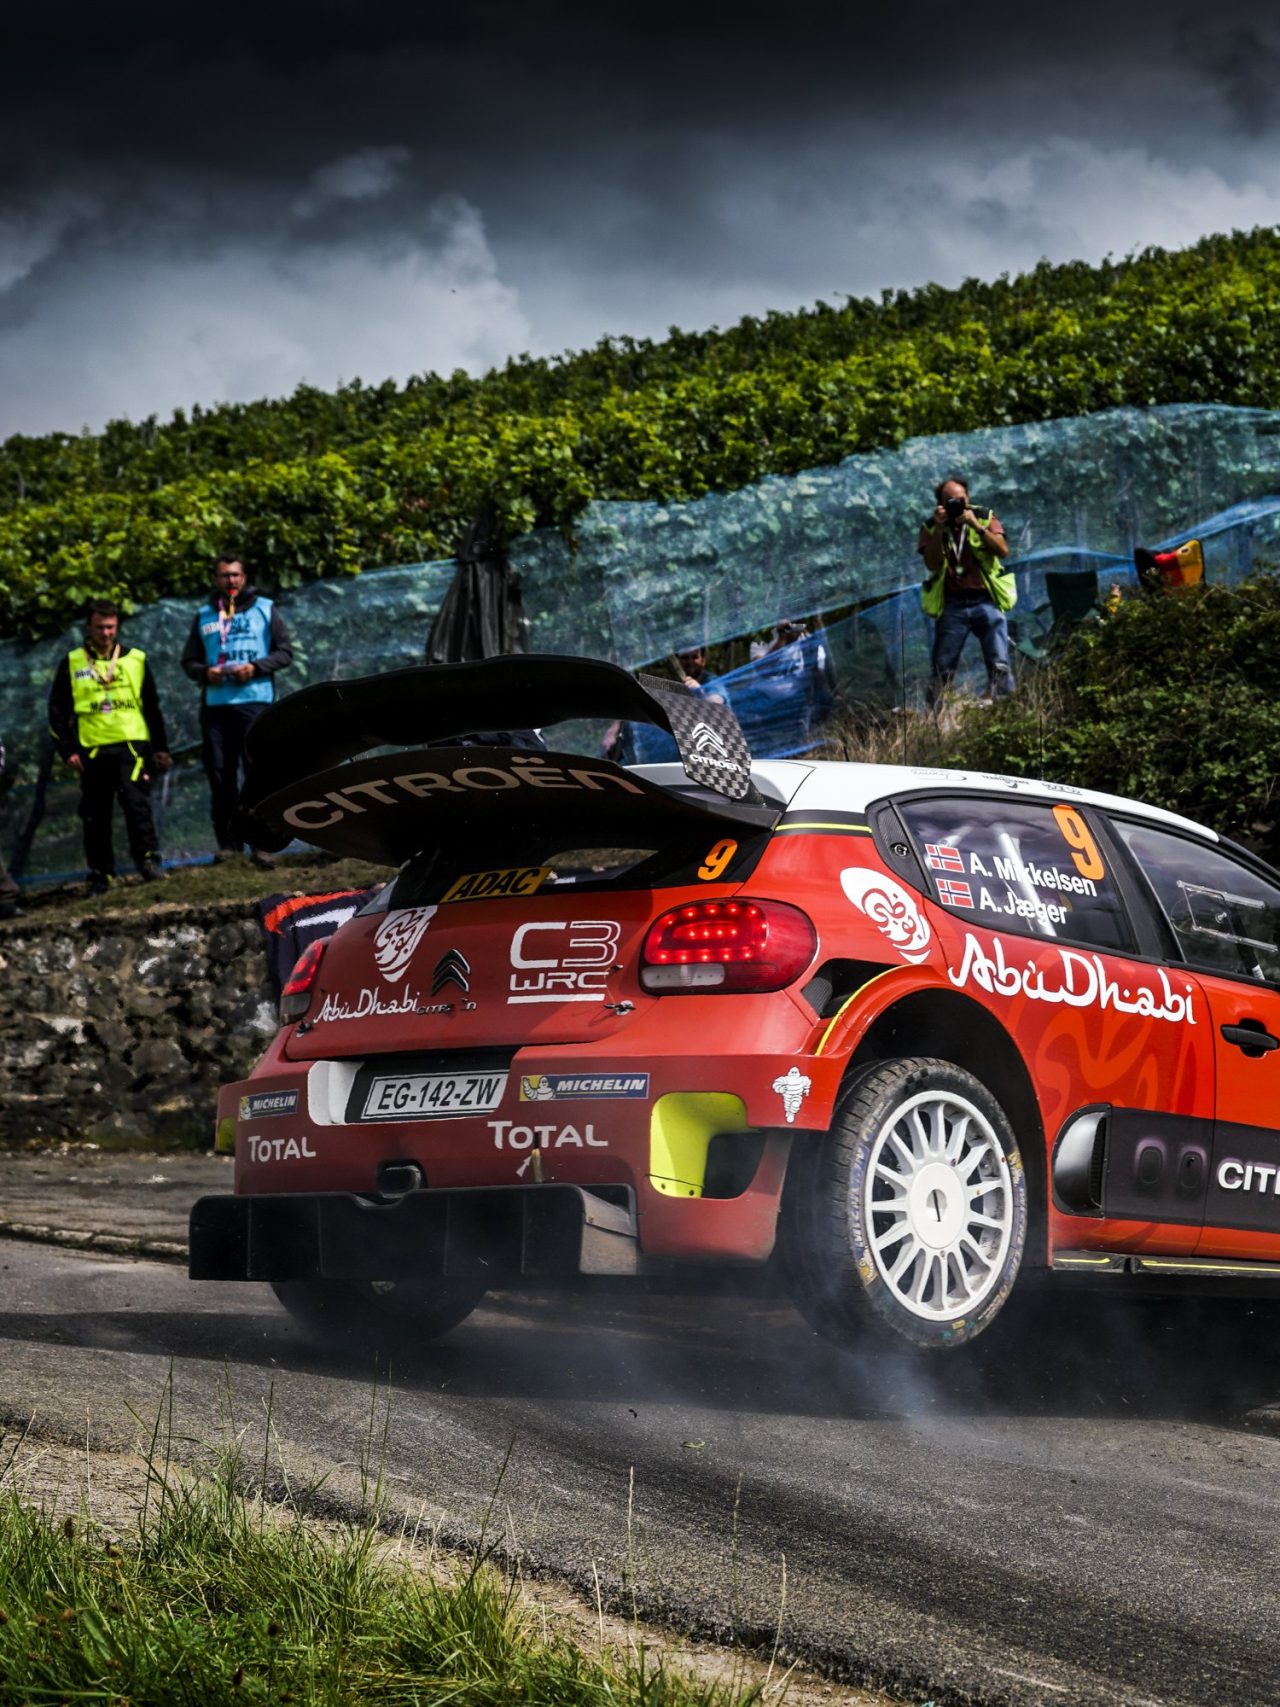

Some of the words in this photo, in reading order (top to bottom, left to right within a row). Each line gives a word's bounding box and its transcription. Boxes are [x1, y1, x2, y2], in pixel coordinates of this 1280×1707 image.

[1052, 804, 1105, 880] 9
[697, 838, 738, 881] 9
[970, 852, 992, 877] A.
[993, 855, 1098, 897] Mikkelsen
[450, 868, 541, 898] ADAC
[980, 887, 1002, 912] A.
[1003, 891, 1067, 926] Jæger
[510, 920, 622, 969] C3
[509, 971, 610, 991] WRC
[947, 933, 1057, 1001] Abu
[1057, 949, 1197, 1025] Dhabi
[356, 983, 420, 1018] Dhabi
[377, 1078, 501, 1110] EG-142-ZW
[556, 1078, 647, 1092] MICHELIN
[252, 1095, 297, 1112] MICHELIN
[248, 1135, 316, 1163] TOTAL
[487, 1120, 609, 1149] TOTAL
